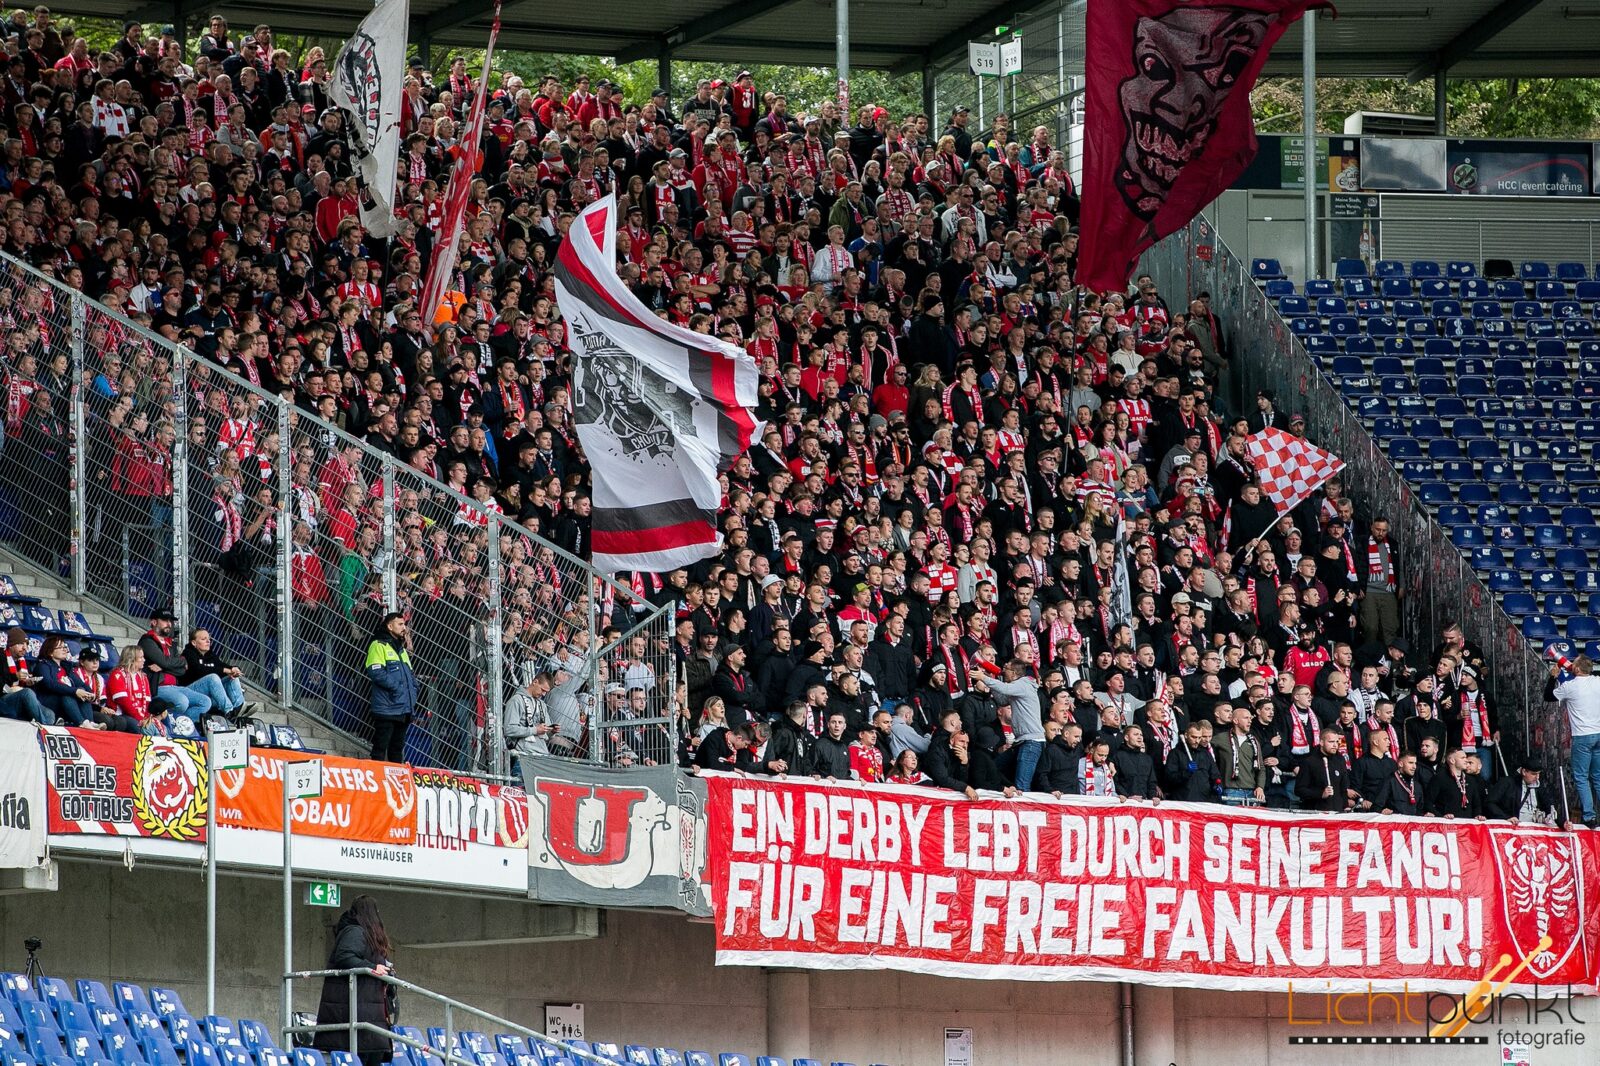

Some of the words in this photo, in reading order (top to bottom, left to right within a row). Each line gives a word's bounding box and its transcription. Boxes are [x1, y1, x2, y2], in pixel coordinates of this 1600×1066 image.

[977, 58, 982, 67] S
[984, 59, 993, 67] 19
[1005, 58, 1009, 67] S
[1010, 56, 1017, 65] 19
[1498, 181, 1517, 190] HCC
[1522, 182, 1583, 193] eventcatering
[46, 735, 81, 760] RED
[221, 740, 239, 748] BLOCK
[224, 750, 228, 759] S
[231, 749, 237, 758] 6
[55, 764, 116, 791] EAGLES
[295, 769, 313, 777] BLOCK
[297, 780, 303, 788] S
[305, 778, 310, 788] 7
[414, 771, 477, 794] sektion
[62, 794, 133, 823] COTTBUS
[416, 783, 497, 846] nord
[732, 788, 795, 853] EIN
[805, 795, 931, 866] DERBY
[943, 806, 1049, 873] LEBT
[1061, 814, 1190, 881] DURCH
[1203, 822, 1326, 888] SEINE
[1337, 828, 1461, 890] FANS!
[341, 846, 413, 863] MASSIVHÄUSER
[723, 845, 825, 942] FÜR
[838, 867, 957, 950] EINE
[970, 879, 1128, 956] FREIE
[1143, 887, 1483, 968] FANKULTUR!
[549, 1016, 561, 1026] WC
